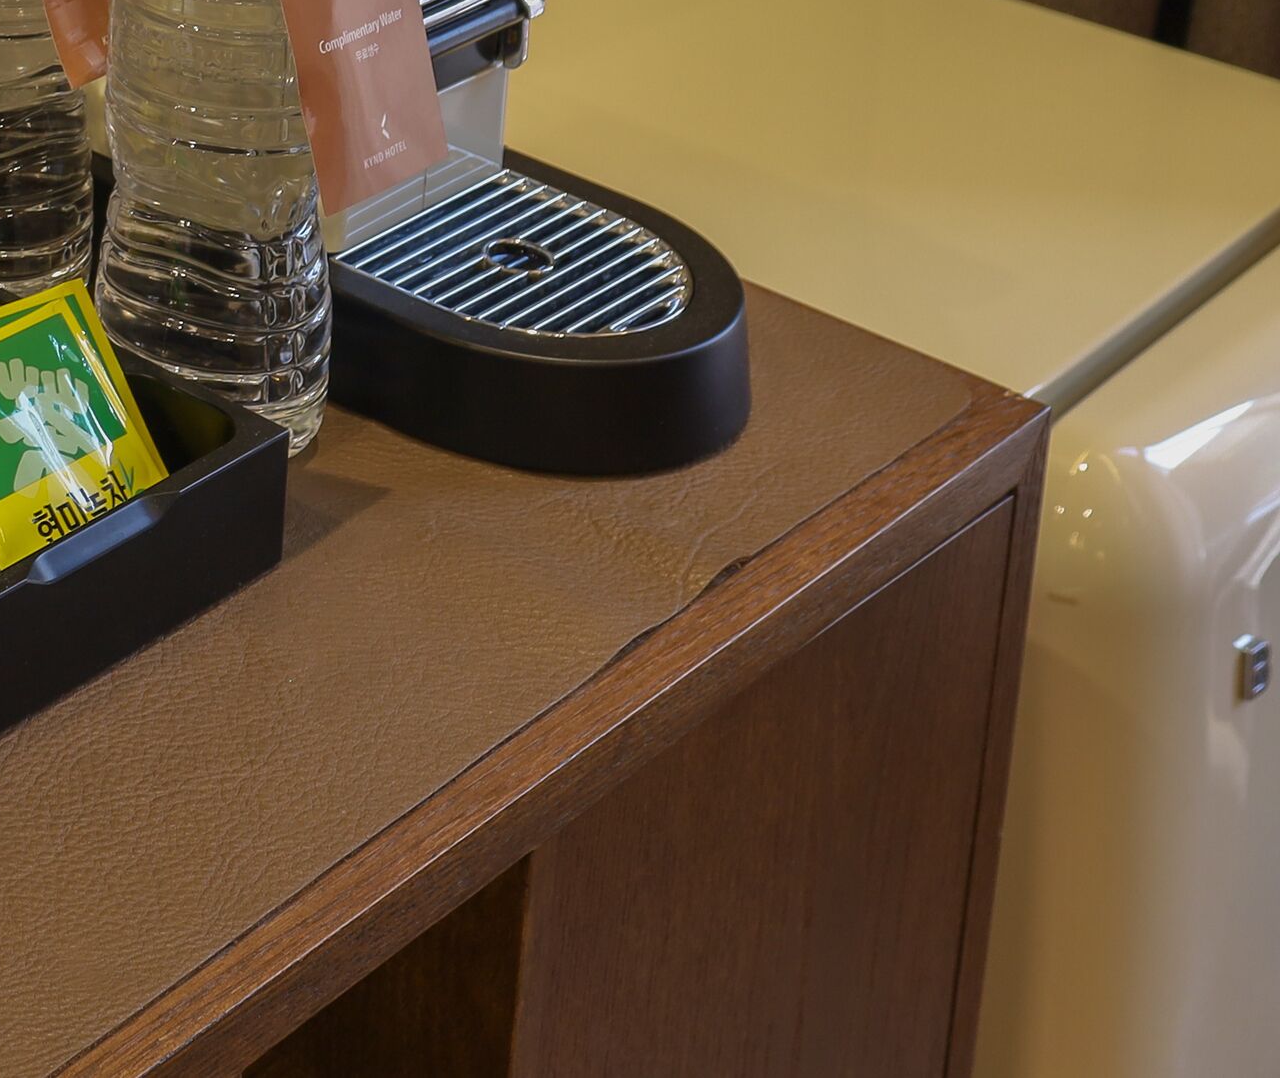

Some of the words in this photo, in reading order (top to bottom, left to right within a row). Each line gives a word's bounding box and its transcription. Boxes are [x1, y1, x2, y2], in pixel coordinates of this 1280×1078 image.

[319, 18, 379, 55] Complimentary
[379, 8, 403, 32] Water
[363, 148, 384, 170] KYND
[384, 140, 407, 161] HOTEL
